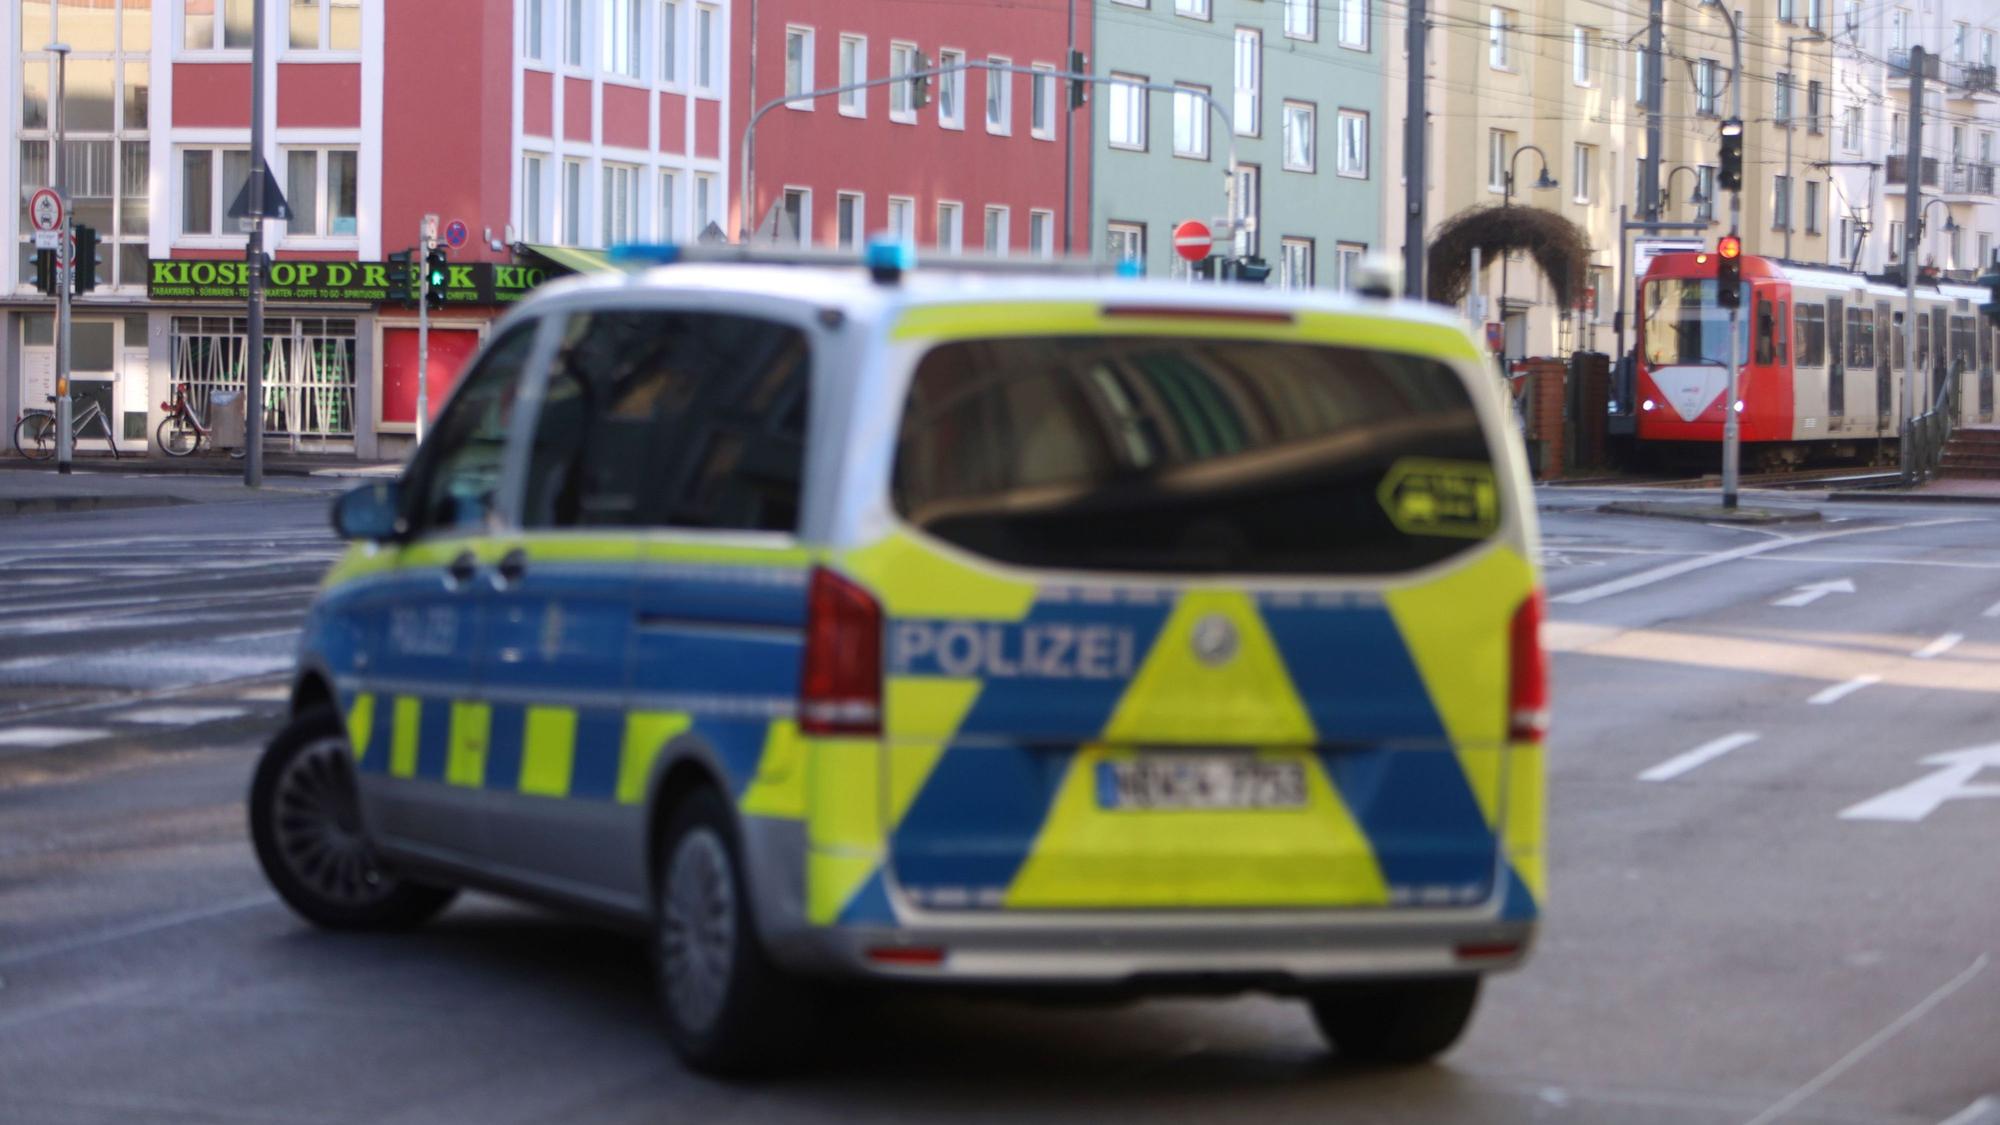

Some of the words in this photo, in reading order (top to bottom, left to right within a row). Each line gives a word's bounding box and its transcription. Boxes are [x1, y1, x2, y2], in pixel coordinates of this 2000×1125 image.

[271, 262, 319, 287] OP
[495, 265, 546, 289] KIO
[891, 619, 1136, 678] POLIZEI
